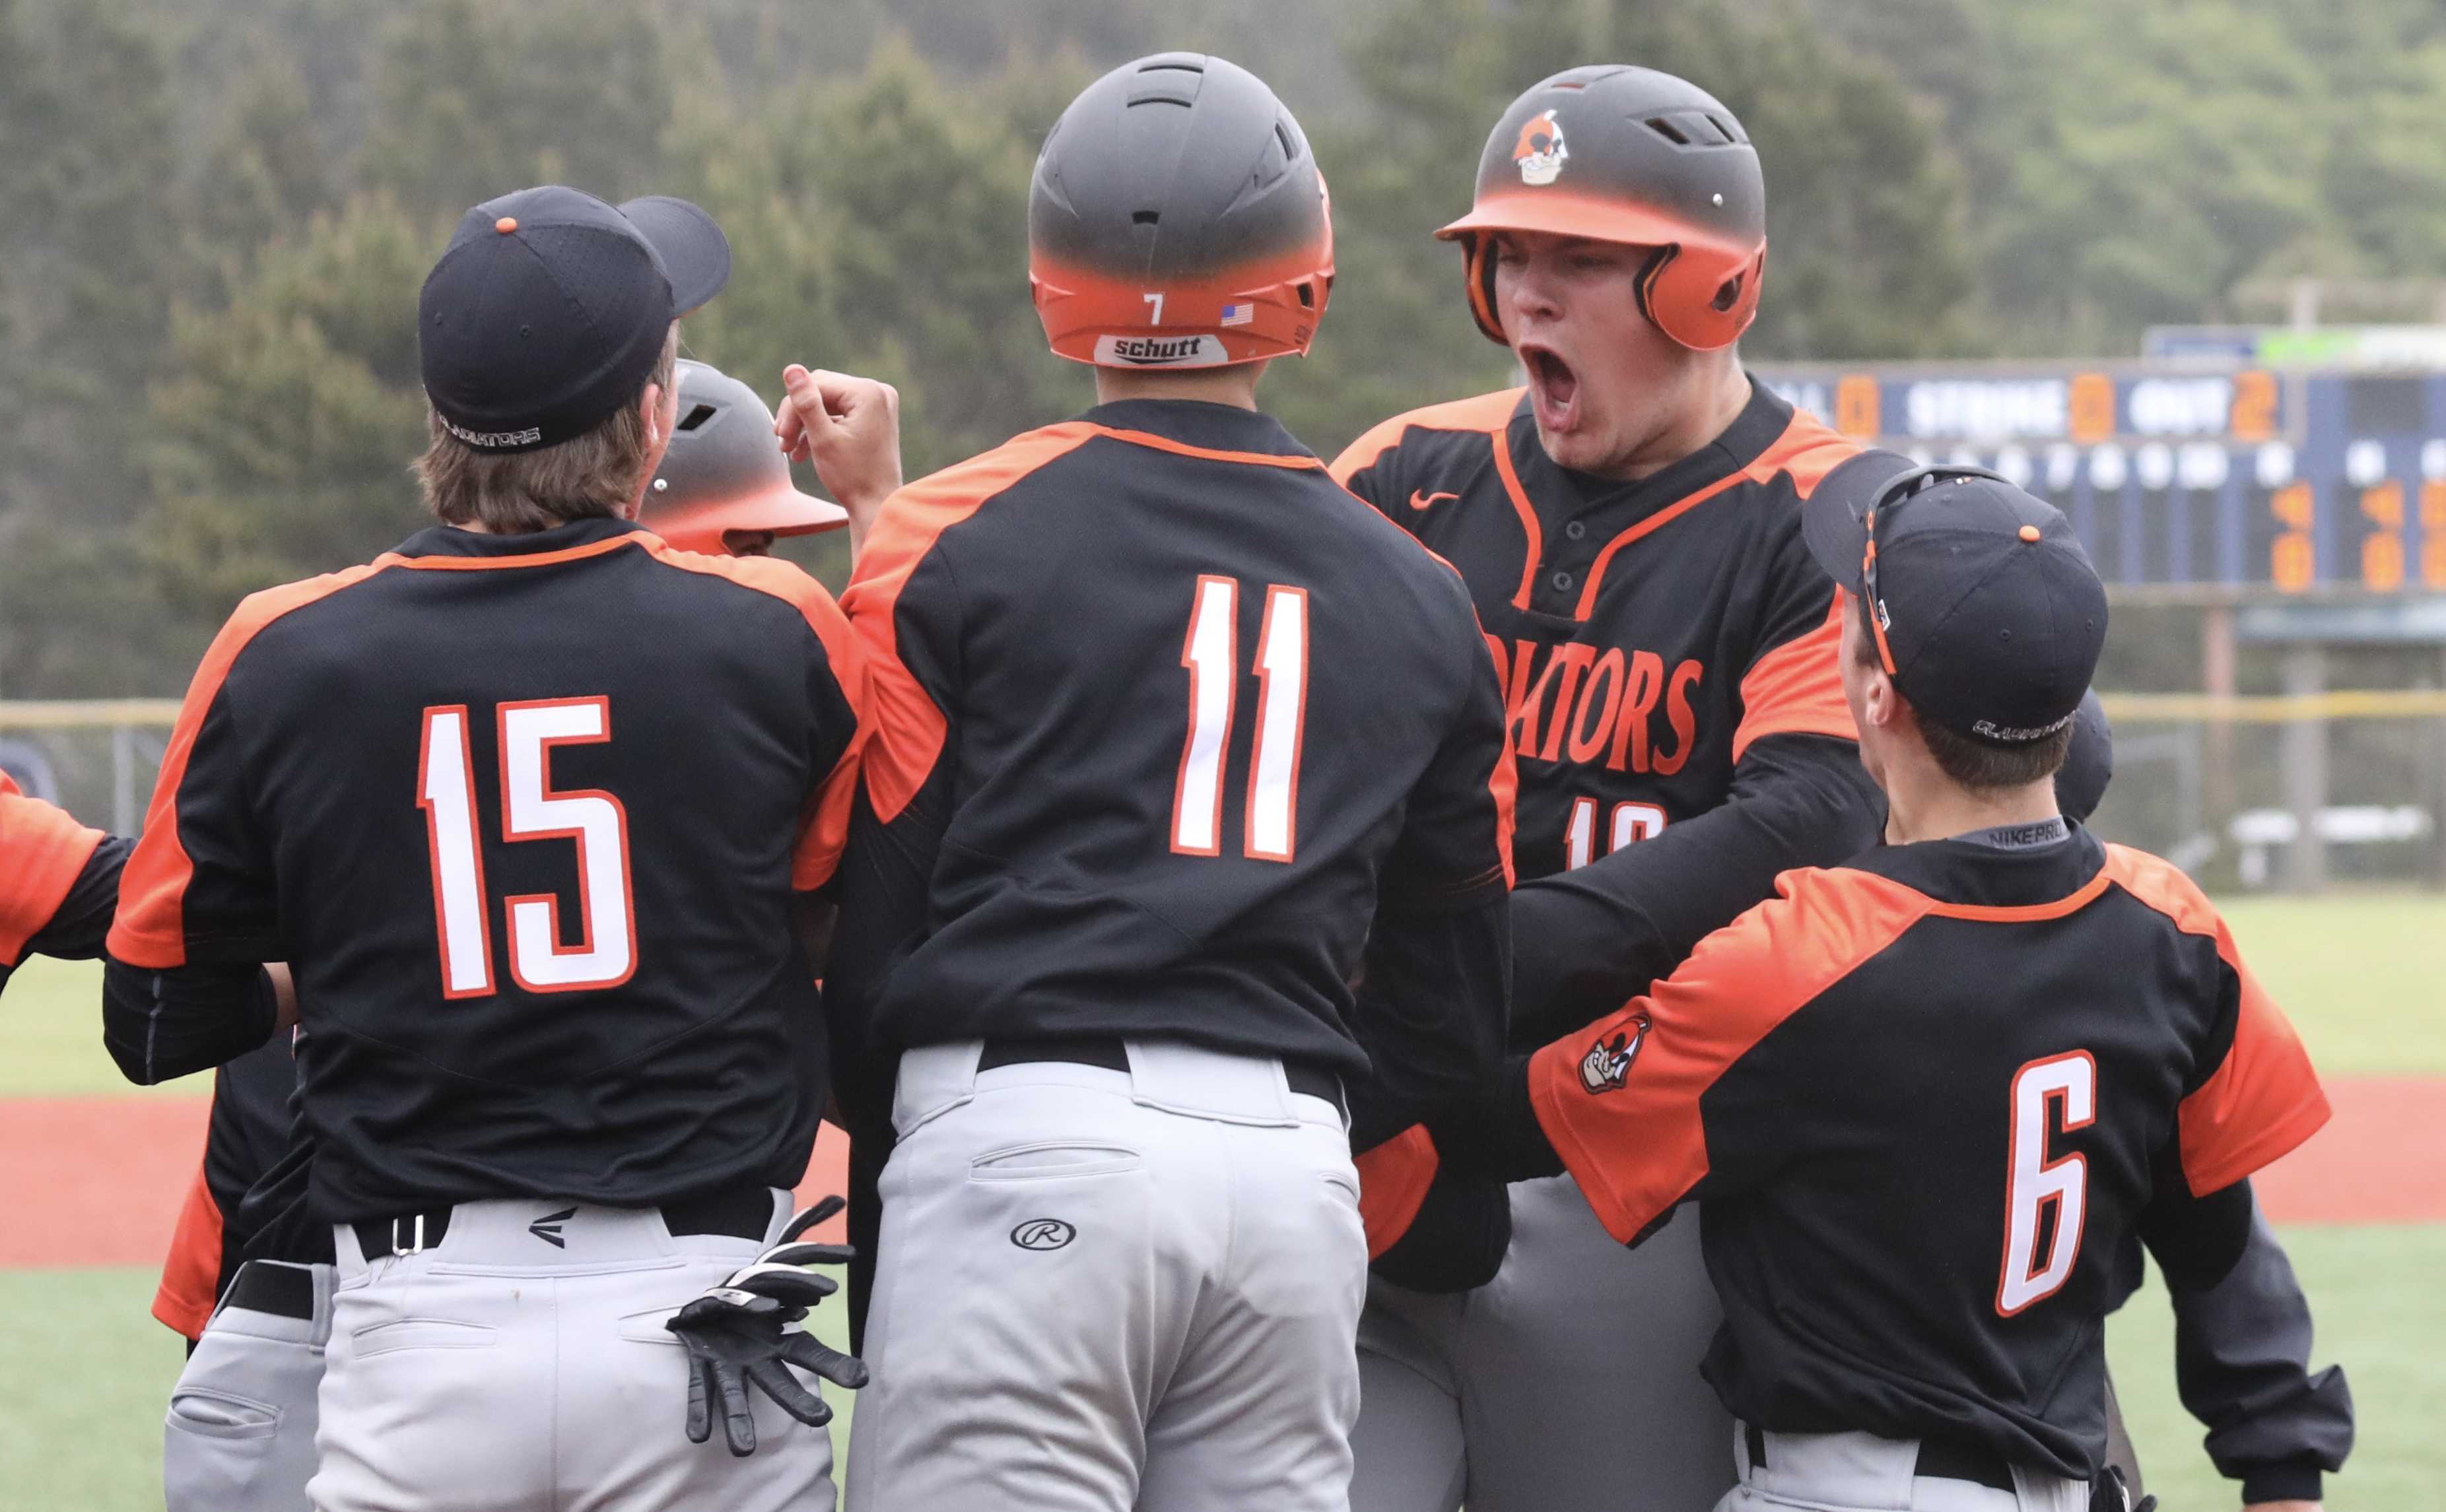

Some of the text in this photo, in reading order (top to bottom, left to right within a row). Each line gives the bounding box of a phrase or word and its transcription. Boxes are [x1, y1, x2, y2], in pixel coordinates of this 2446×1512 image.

[1143, 293, 1164, 325] 7
[1114, 337, 1201, 357] schutt
[437, 411, 541, 447] ADIATORS
[2231, 370, 2279, 442] 2
[1170, 574, 1309, 863] 11
[1483, 633, 1704, 776] IATORS
[416, 695, 638, 1000] 15
[1989, 826, 2033, 845] NIKE
[1994, 1048, 2096, 1318] 6
